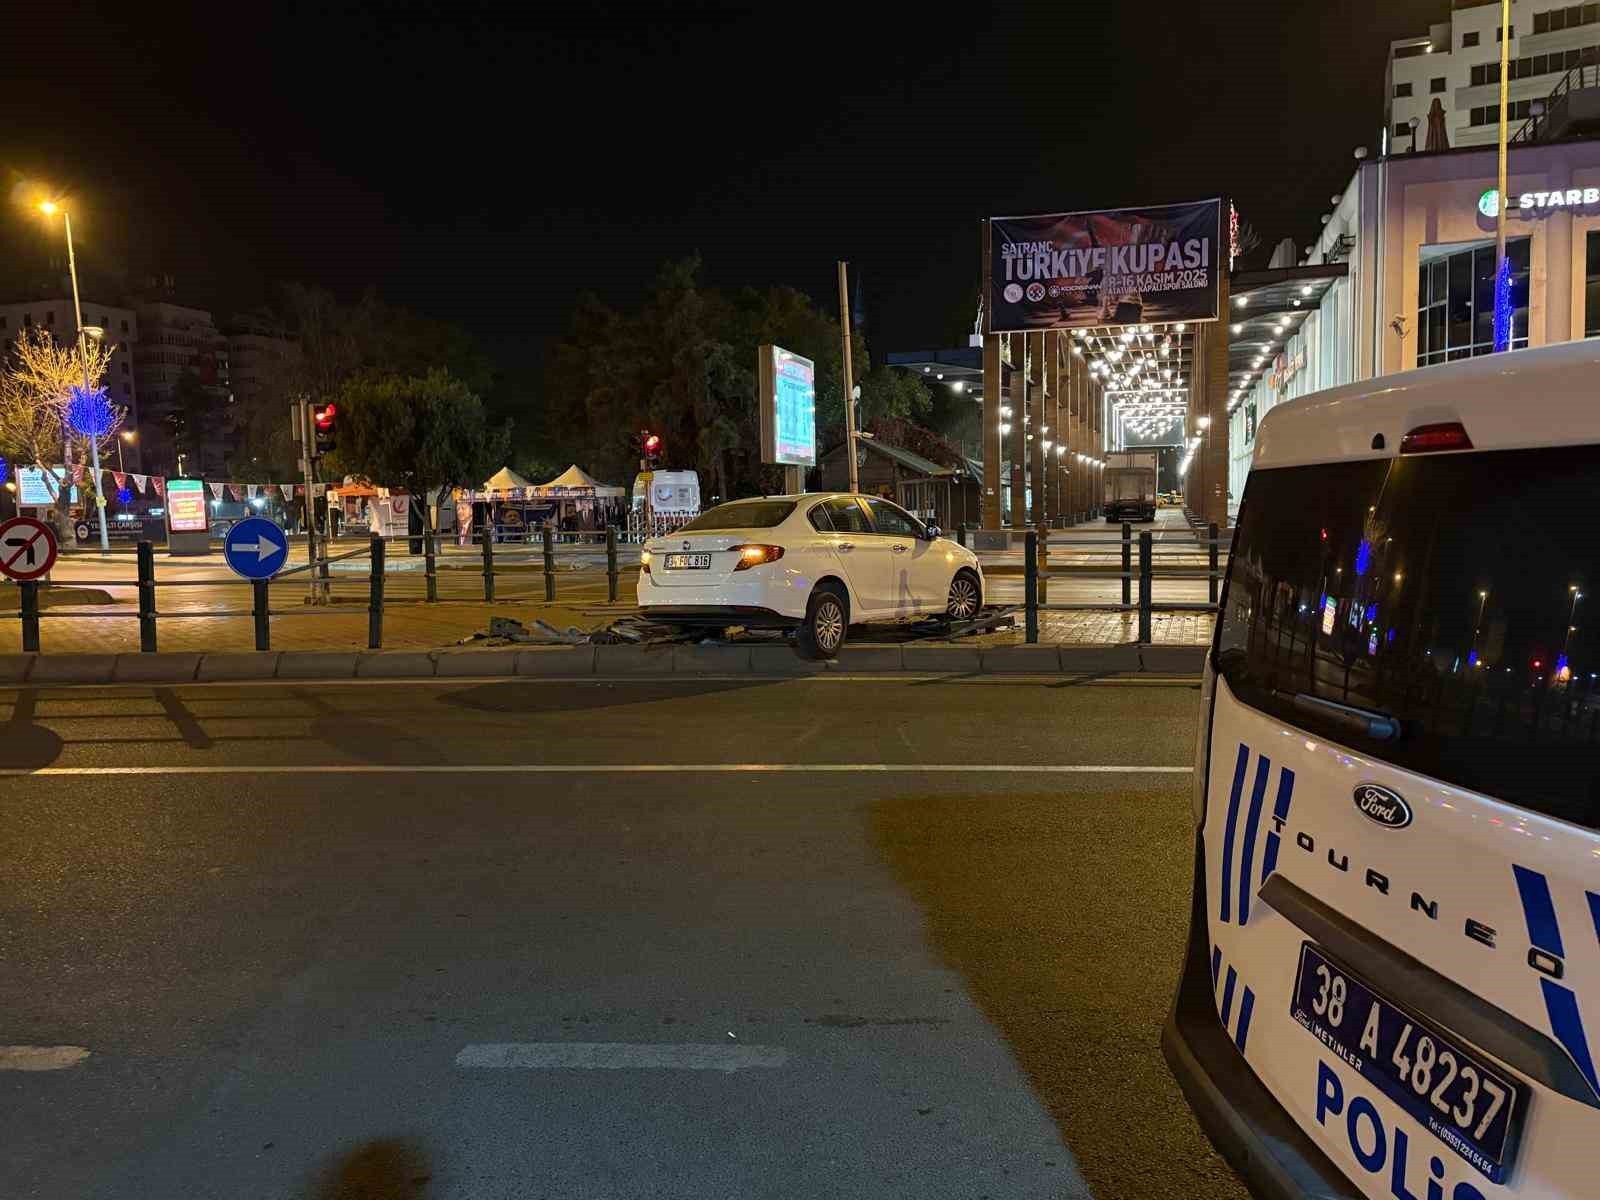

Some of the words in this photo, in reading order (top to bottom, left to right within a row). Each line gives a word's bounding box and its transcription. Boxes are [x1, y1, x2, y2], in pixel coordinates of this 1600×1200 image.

[1520, 188, 1600, 209] STARB
[1112, 238, 1209, 274] KUPASI
[1136, 271, 1175, 286] KASIM
[1176, 269, 1208, 282] 2025
[1360, 788, 1396, 822] Ford
[1272, 815, 1564, 980] TOURNEO
[1312, 964, 1347, 1028] 38
[1359, 1001, 1381, 1060] A
[1391, 1023, 1506, 1140] 48237
